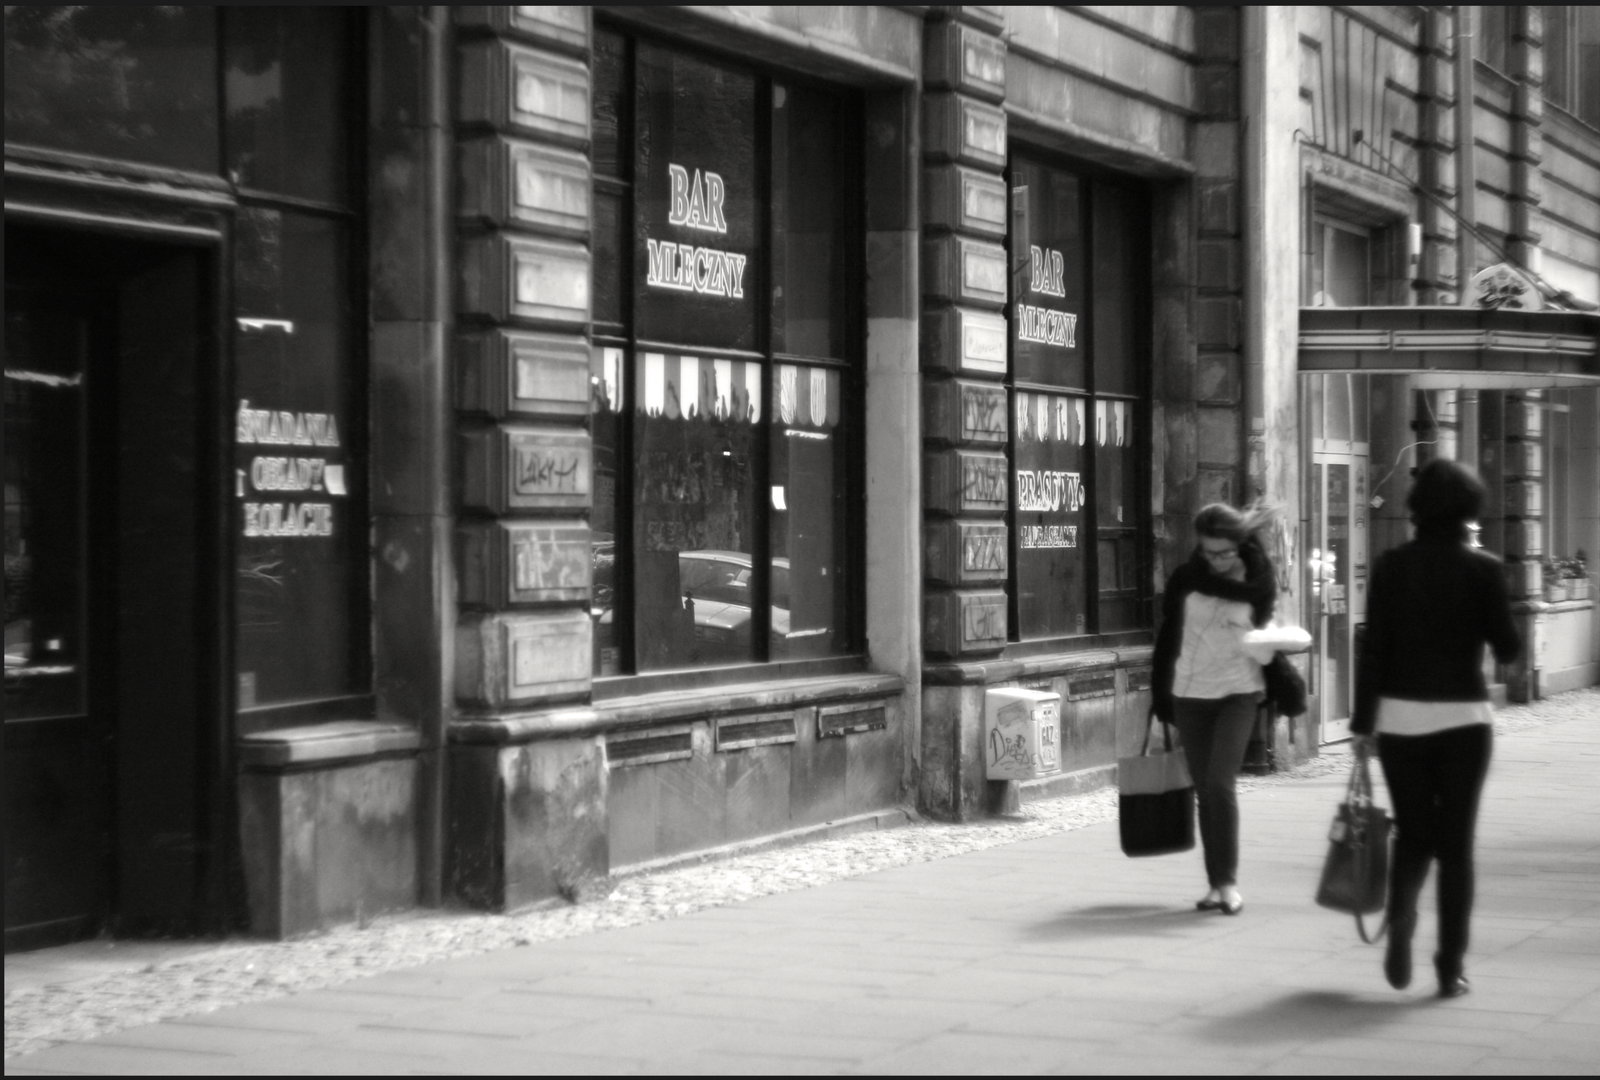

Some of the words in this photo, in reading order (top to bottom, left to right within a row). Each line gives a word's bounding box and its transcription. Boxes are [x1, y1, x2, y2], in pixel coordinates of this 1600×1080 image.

[668, 162, 727, 234] BAR
[646, 237, 747, 299] MLECZNY
[1030, 244, 1066, 298] BAR
[1018, 303, 1078, 348] MLECZNY
[251, 455, 326, 492] OBIADY
[243, 502, 333, 537] KOLACJE
